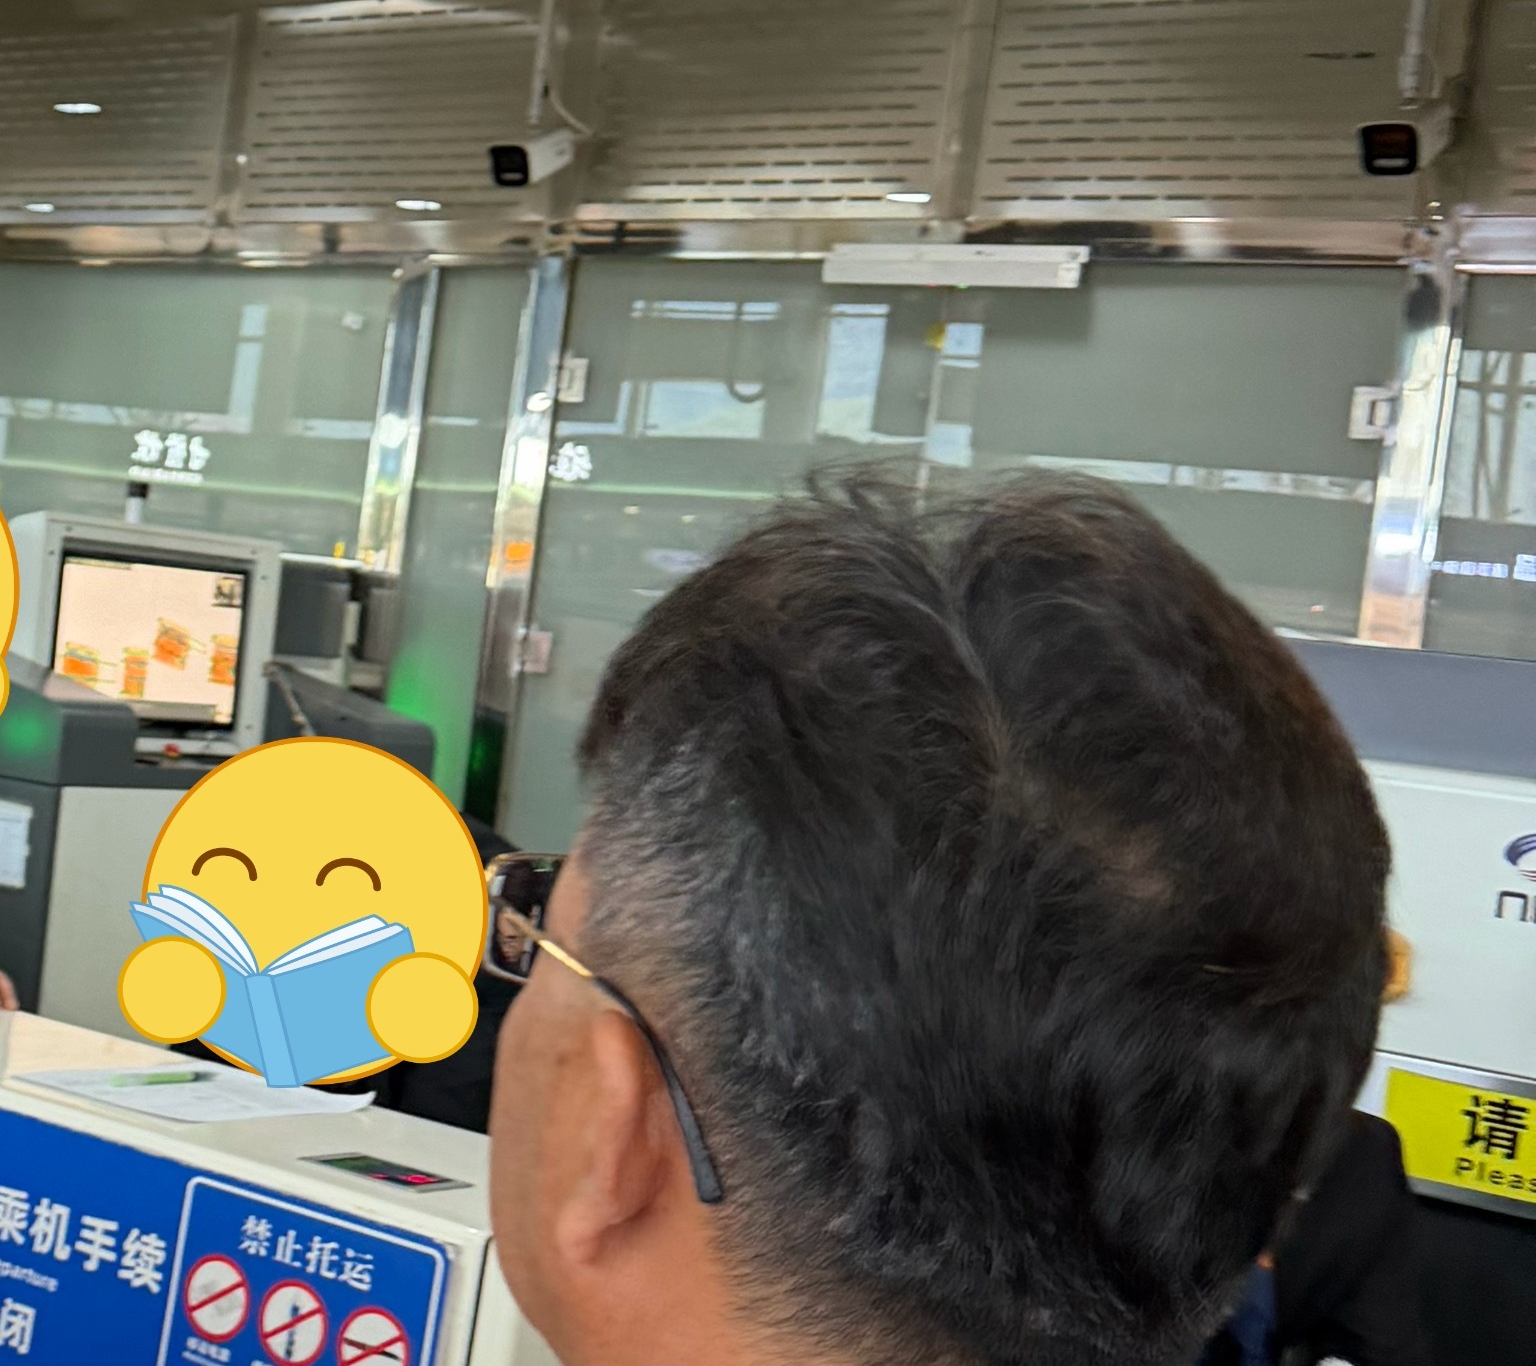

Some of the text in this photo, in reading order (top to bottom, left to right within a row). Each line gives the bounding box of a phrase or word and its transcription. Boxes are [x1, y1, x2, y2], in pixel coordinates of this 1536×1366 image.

[1462, 1095, 1531, 1160] 请
[238, 1214, 375, 1292] 禁止托运
